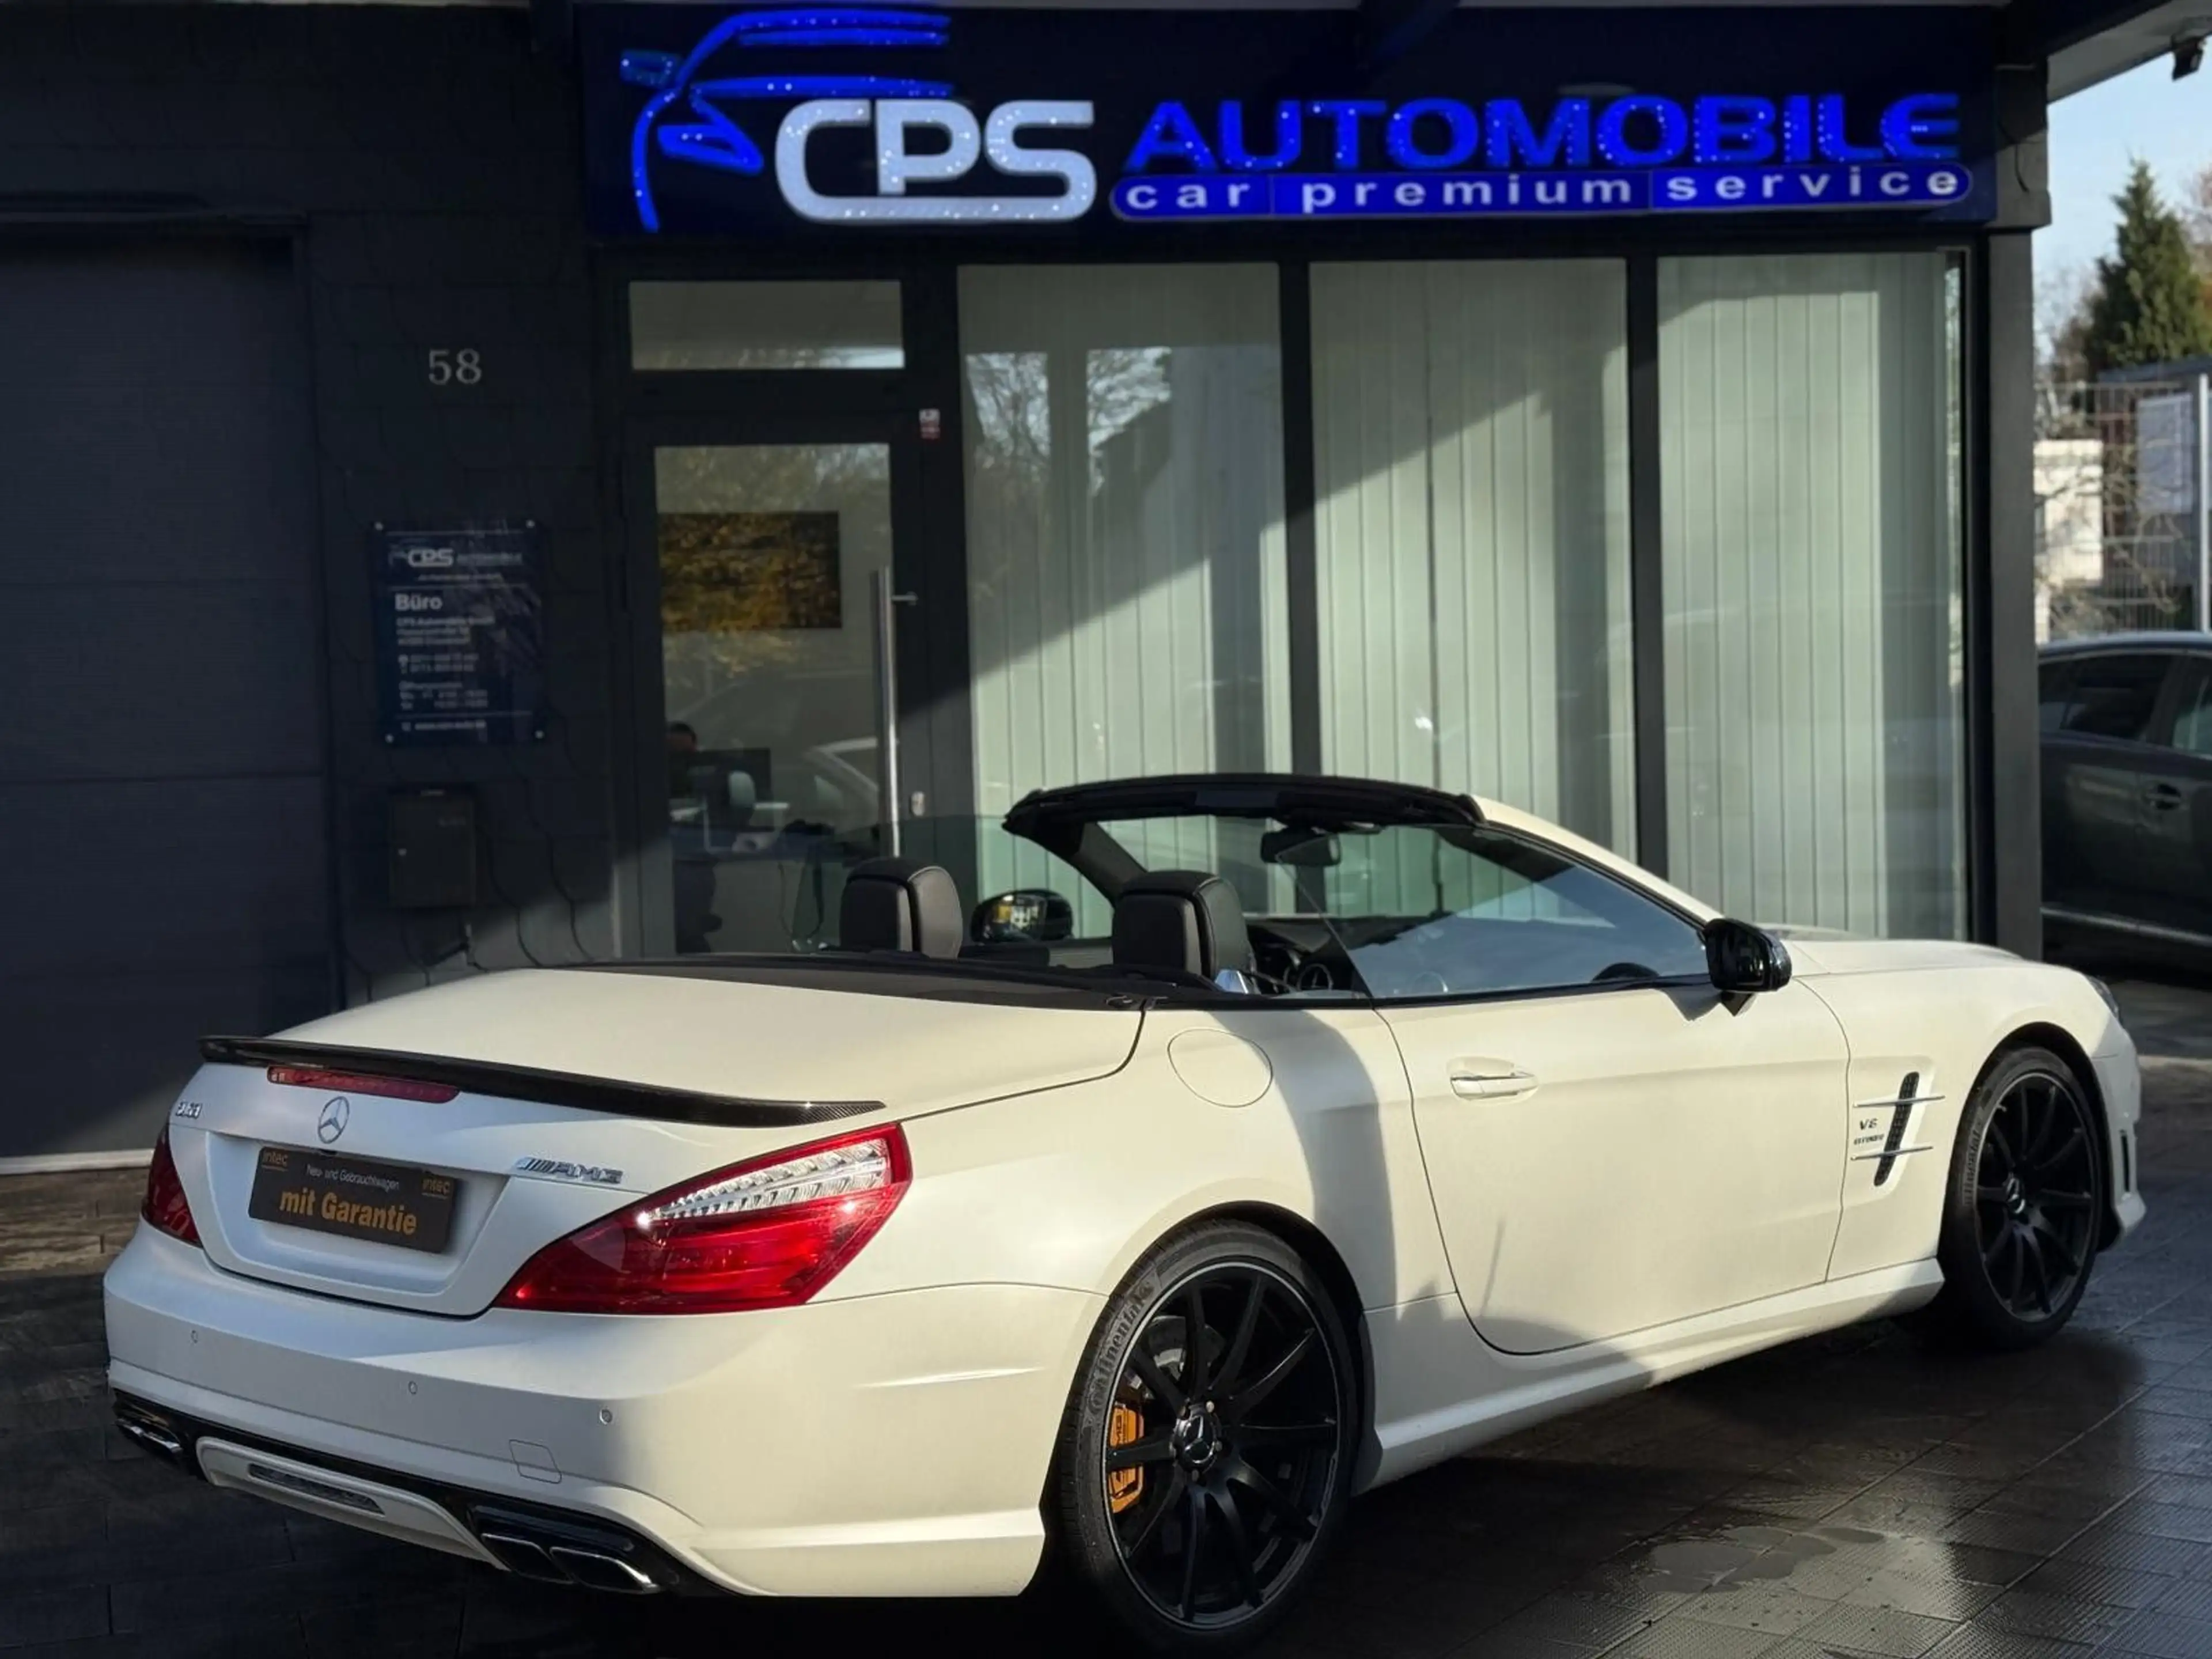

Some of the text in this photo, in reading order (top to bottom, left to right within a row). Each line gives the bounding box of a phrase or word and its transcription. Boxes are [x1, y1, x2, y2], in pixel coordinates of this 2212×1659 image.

[1125, 93, 1959, 171] AUTOMOBILE
[775, 99, 1097, 223] CPS
[1126, 166, 1958, 214] car premium service
[429, 348, 482, 385] 58
[407, 548, 454, 568] CPS
[394, 592, 442, 612] Büro
[279, 1186, 418, 1236] mit Garantie
